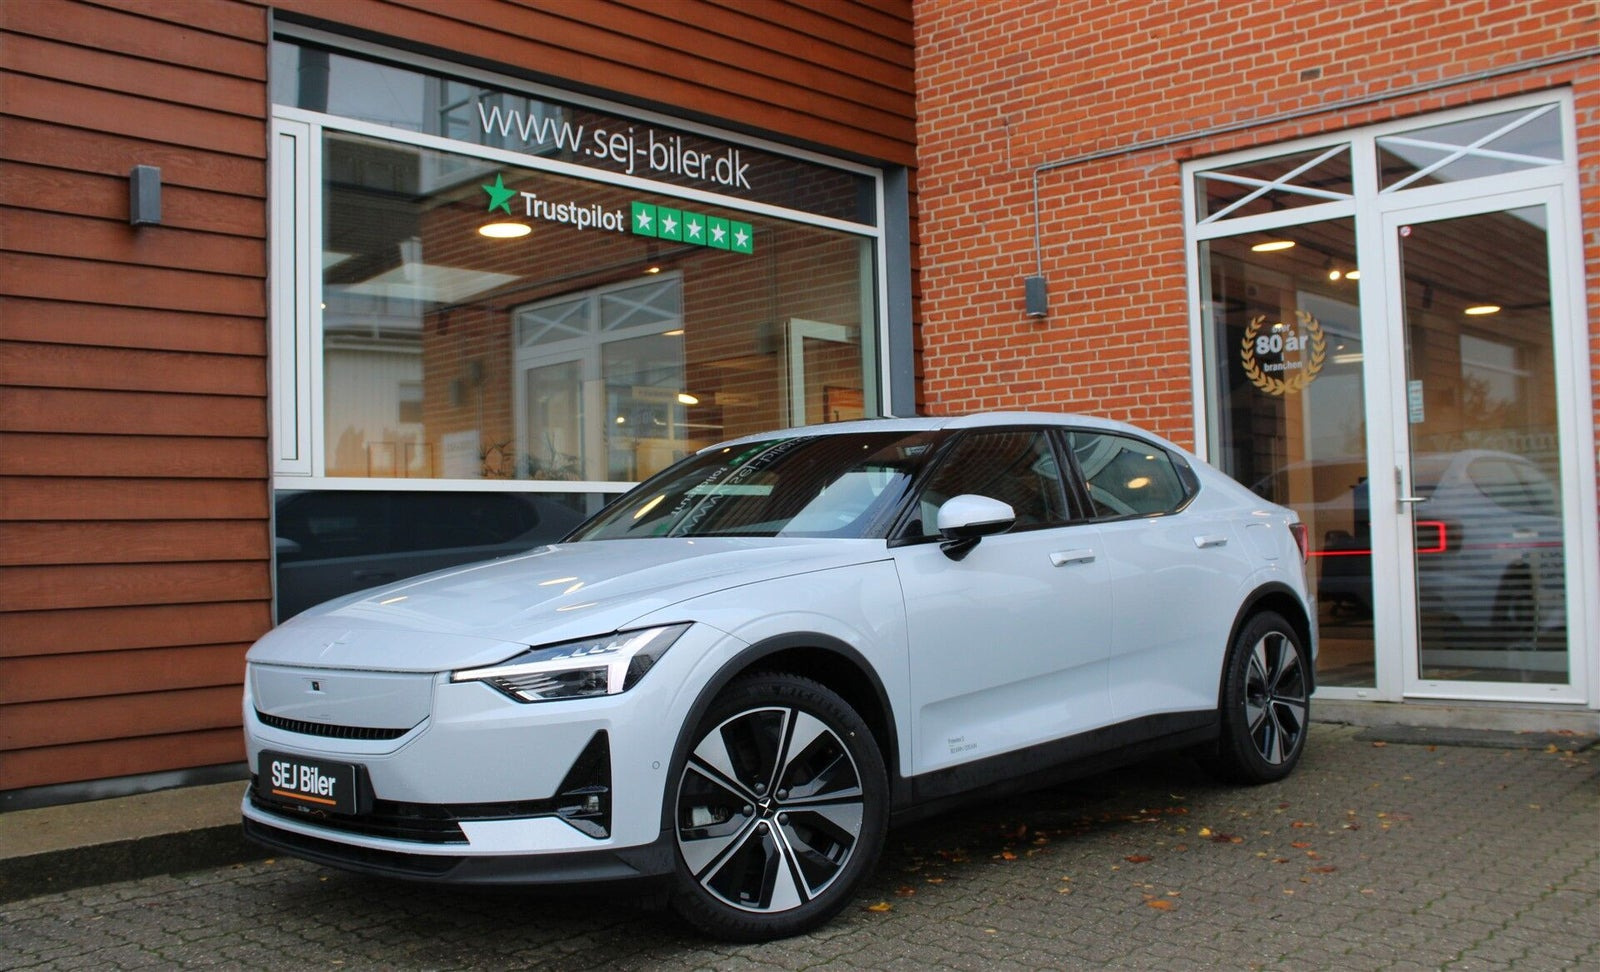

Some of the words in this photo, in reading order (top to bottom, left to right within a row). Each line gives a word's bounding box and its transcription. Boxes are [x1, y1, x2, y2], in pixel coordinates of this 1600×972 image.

[478, 102, 751, 190] www.sej-biler.dk
[520, 191, 625, 232] Trustpilot
[1256, 334, 1283, 355] 80
[1285, 330, 1309, 352] år
[1263, 361, 1303, 373] branchen
[271, 760, 297, 789] SEJ
[300, 765, 337, 796] Biler
